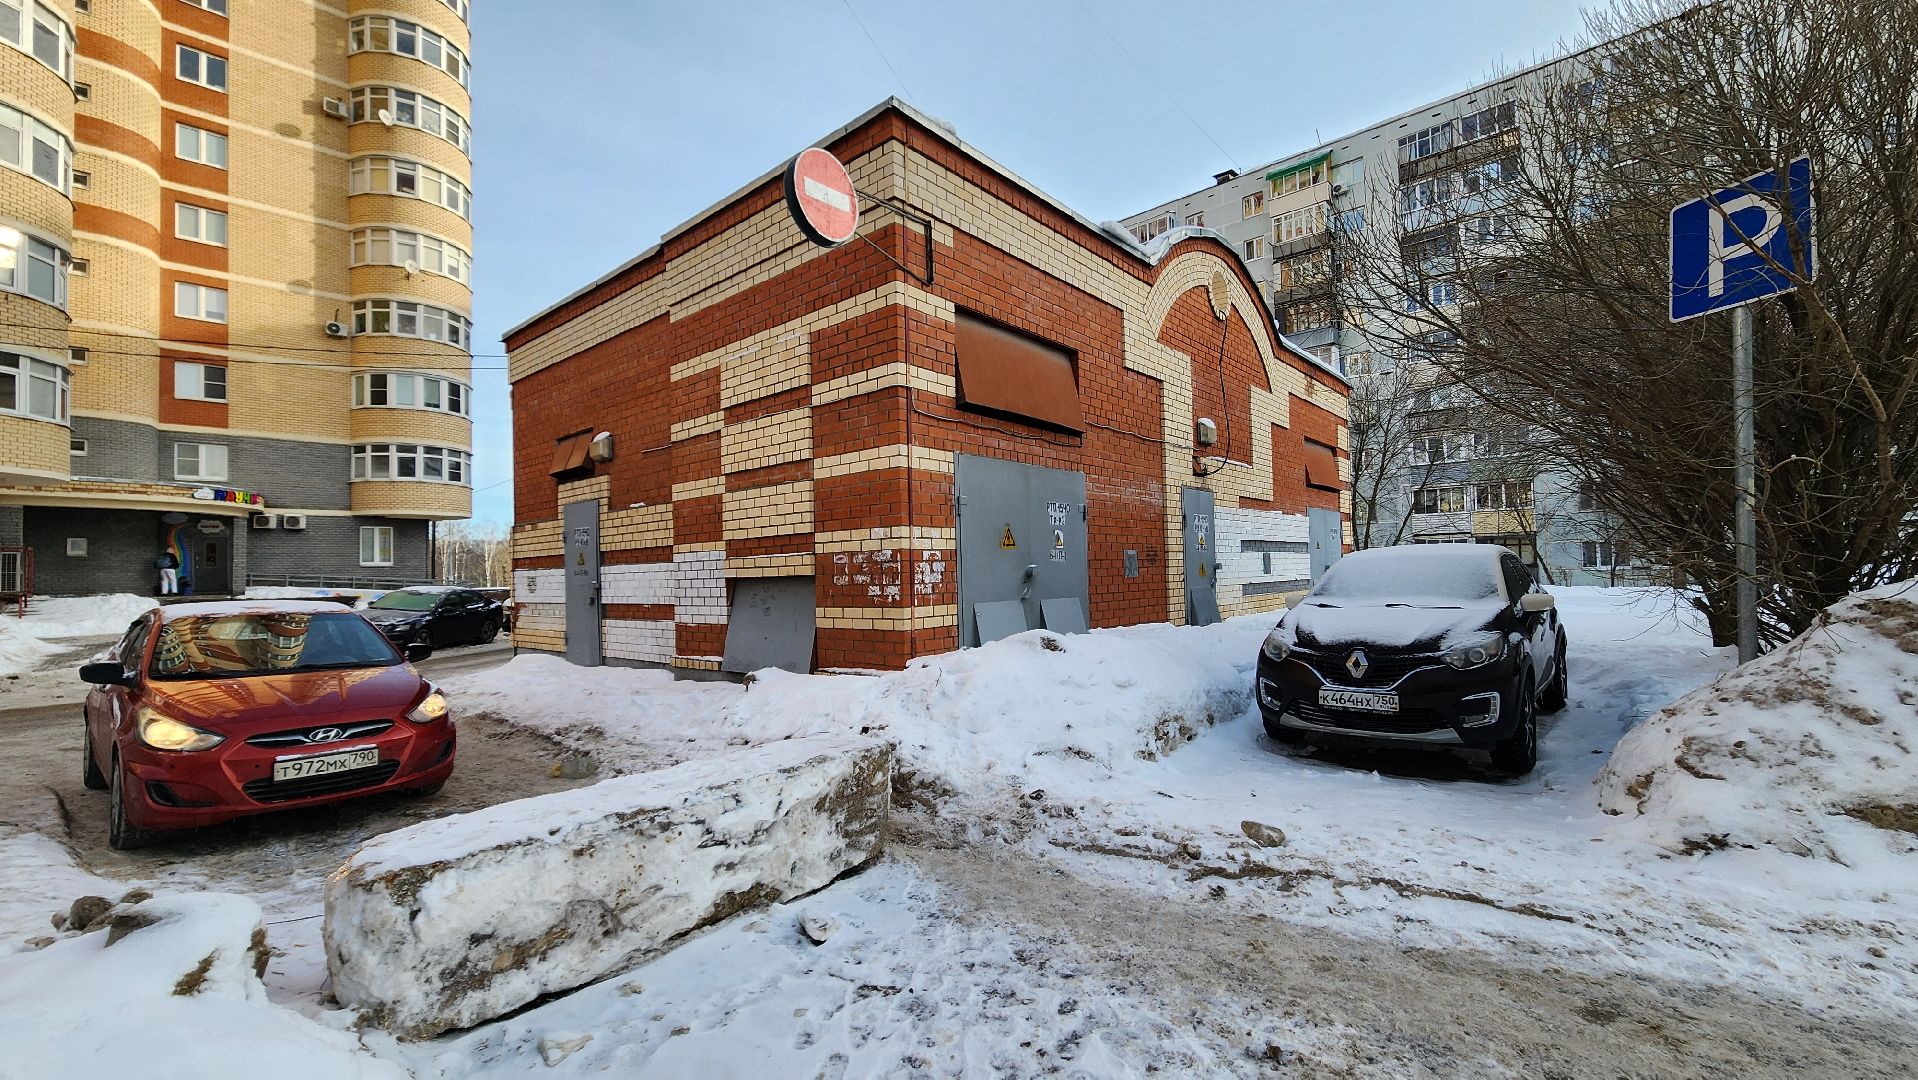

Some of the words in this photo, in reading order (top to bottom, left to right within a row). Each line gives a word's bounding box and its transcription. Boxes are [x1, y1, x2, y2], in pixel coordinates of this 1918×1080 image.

[1708, 193, 1783, 298] P
[1322, 692, 1373, 708] К464НХ
[1374, 695, 1395, 706] 750
[280, 758, 348, 778] Т972МХ
[350, 750, 375, 764] 790
